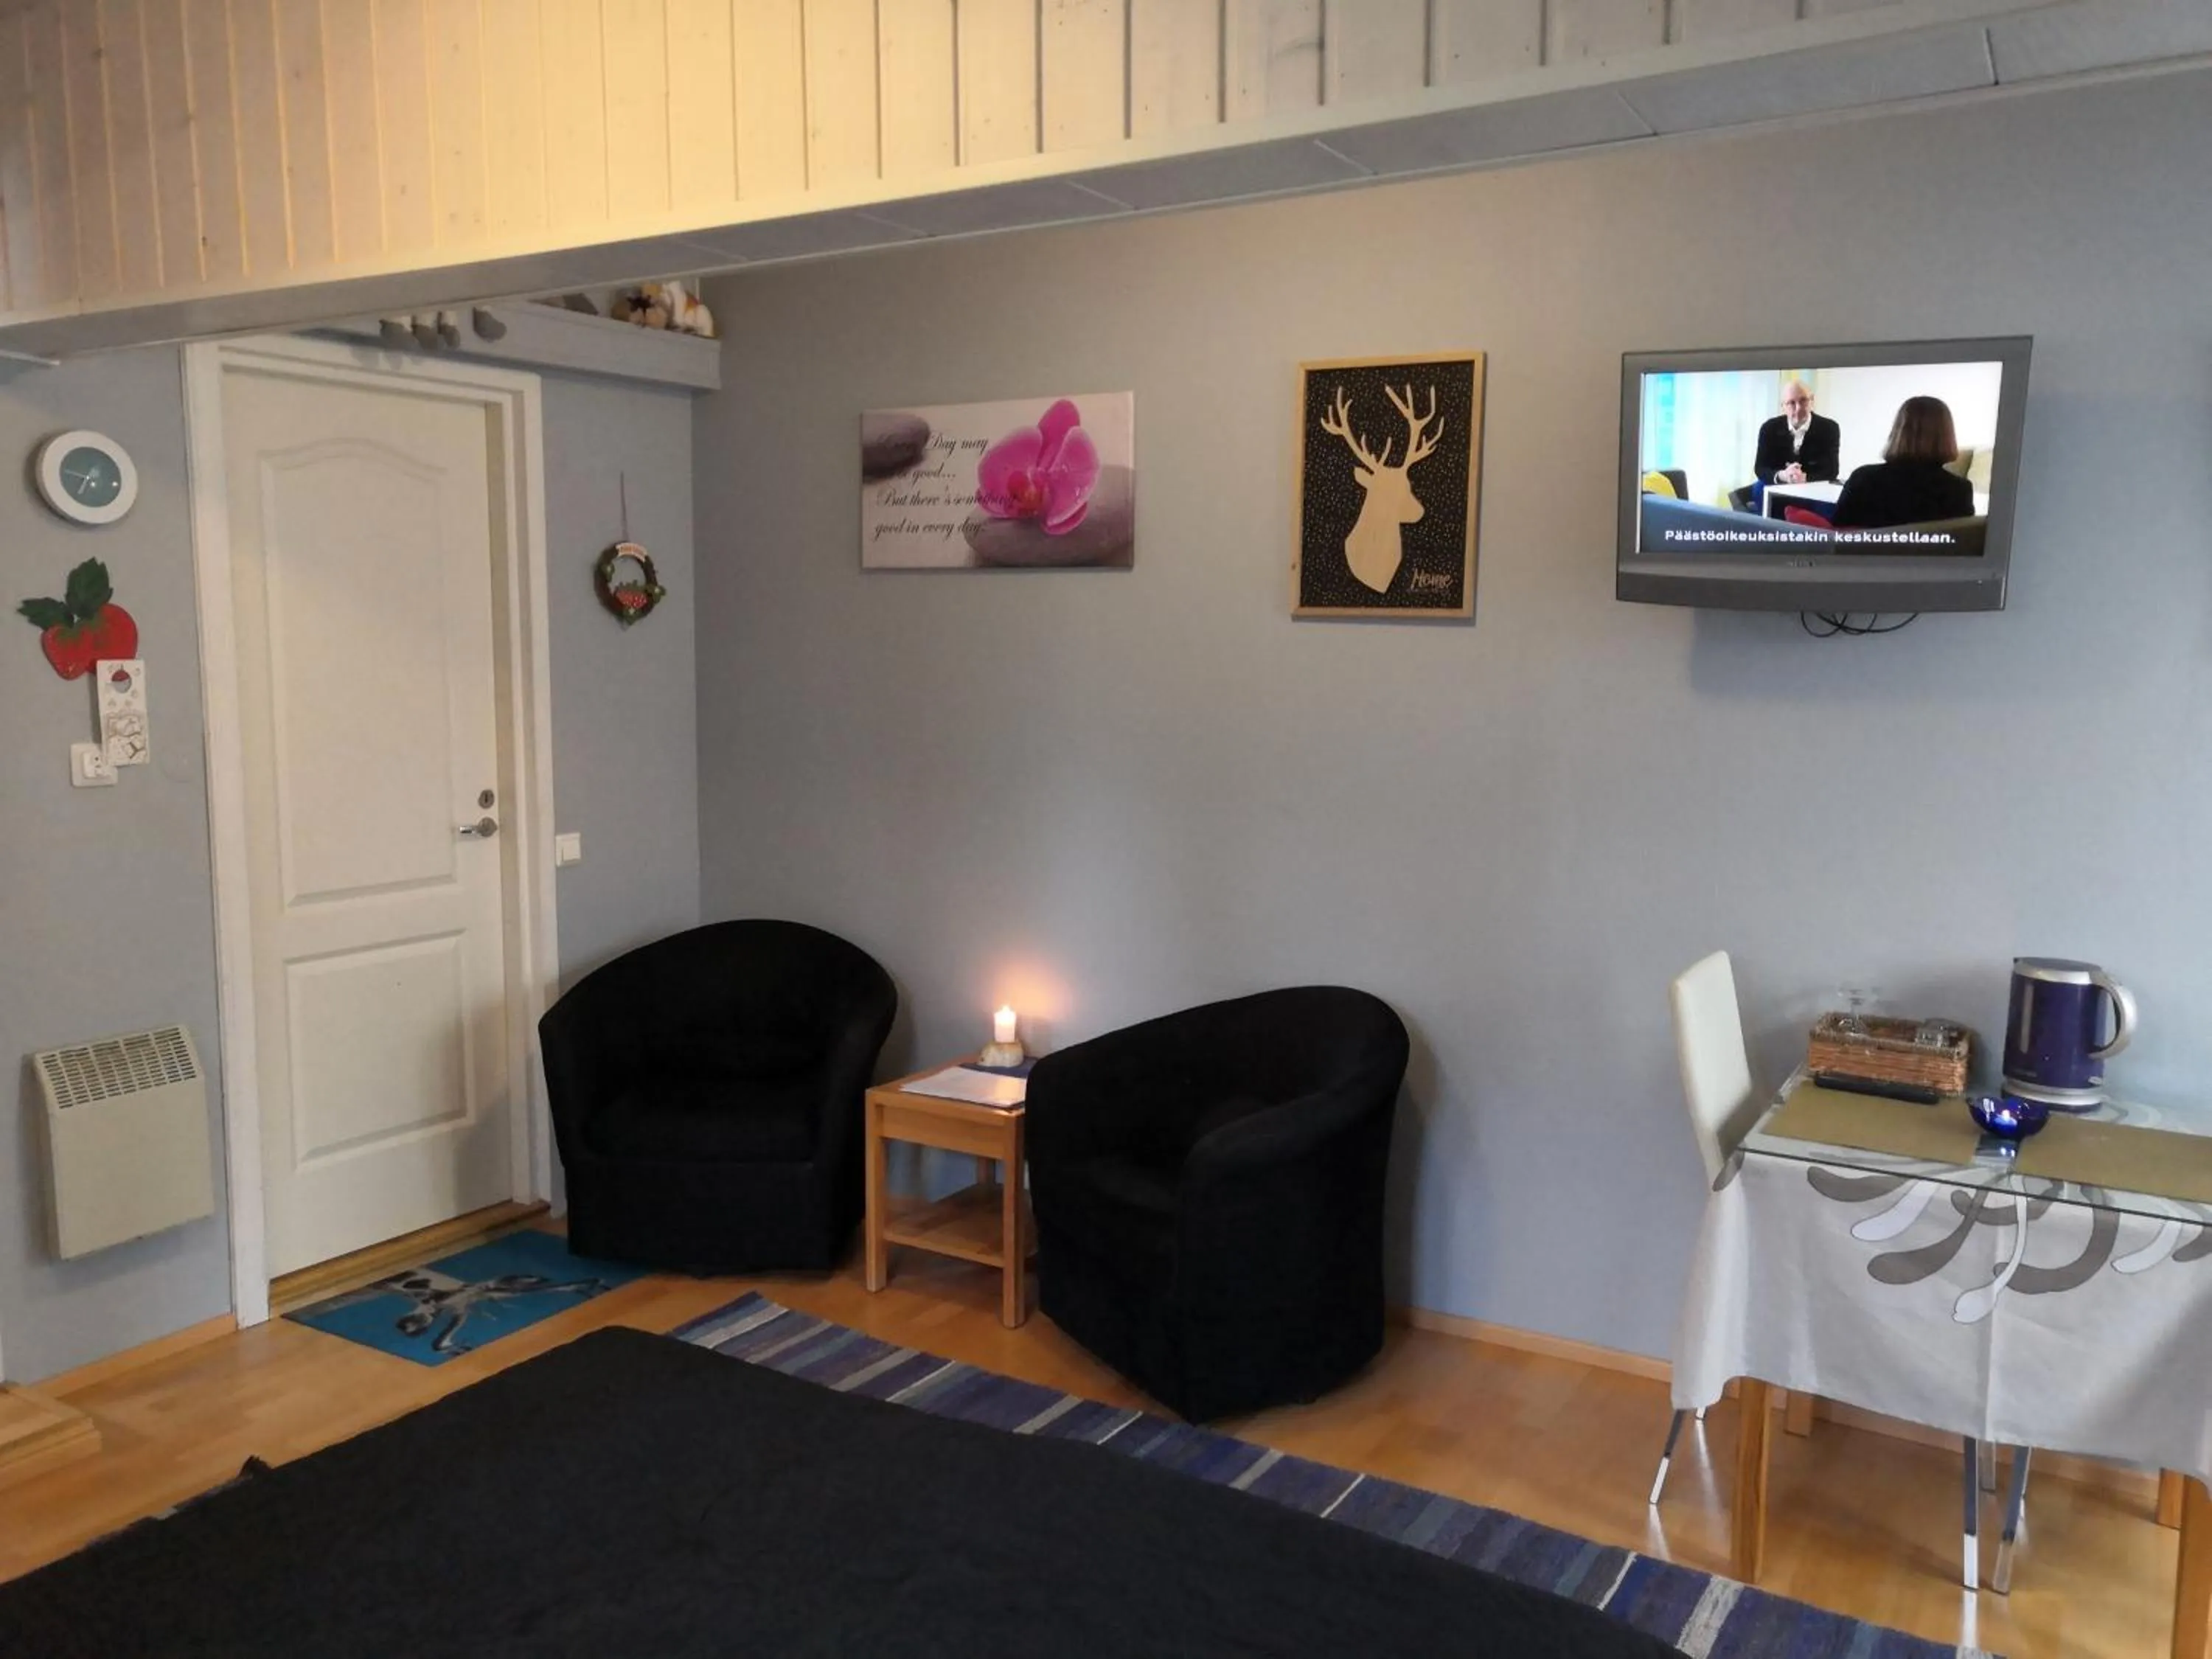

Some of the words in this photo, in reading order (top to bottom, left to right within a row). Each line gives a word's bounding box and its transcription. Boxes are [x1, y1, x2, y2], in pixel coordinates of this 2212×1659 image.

[961, 439, 989, 456] may
[877, 488, 907, 507] But
[873, 518, 906, 541] good
[906, 520, 919, 534] in
[922, 523, 955, 540] every
[1834, 531, 1956, 544] keskustellaan.
[1411, 568, 1454, 590] Home
